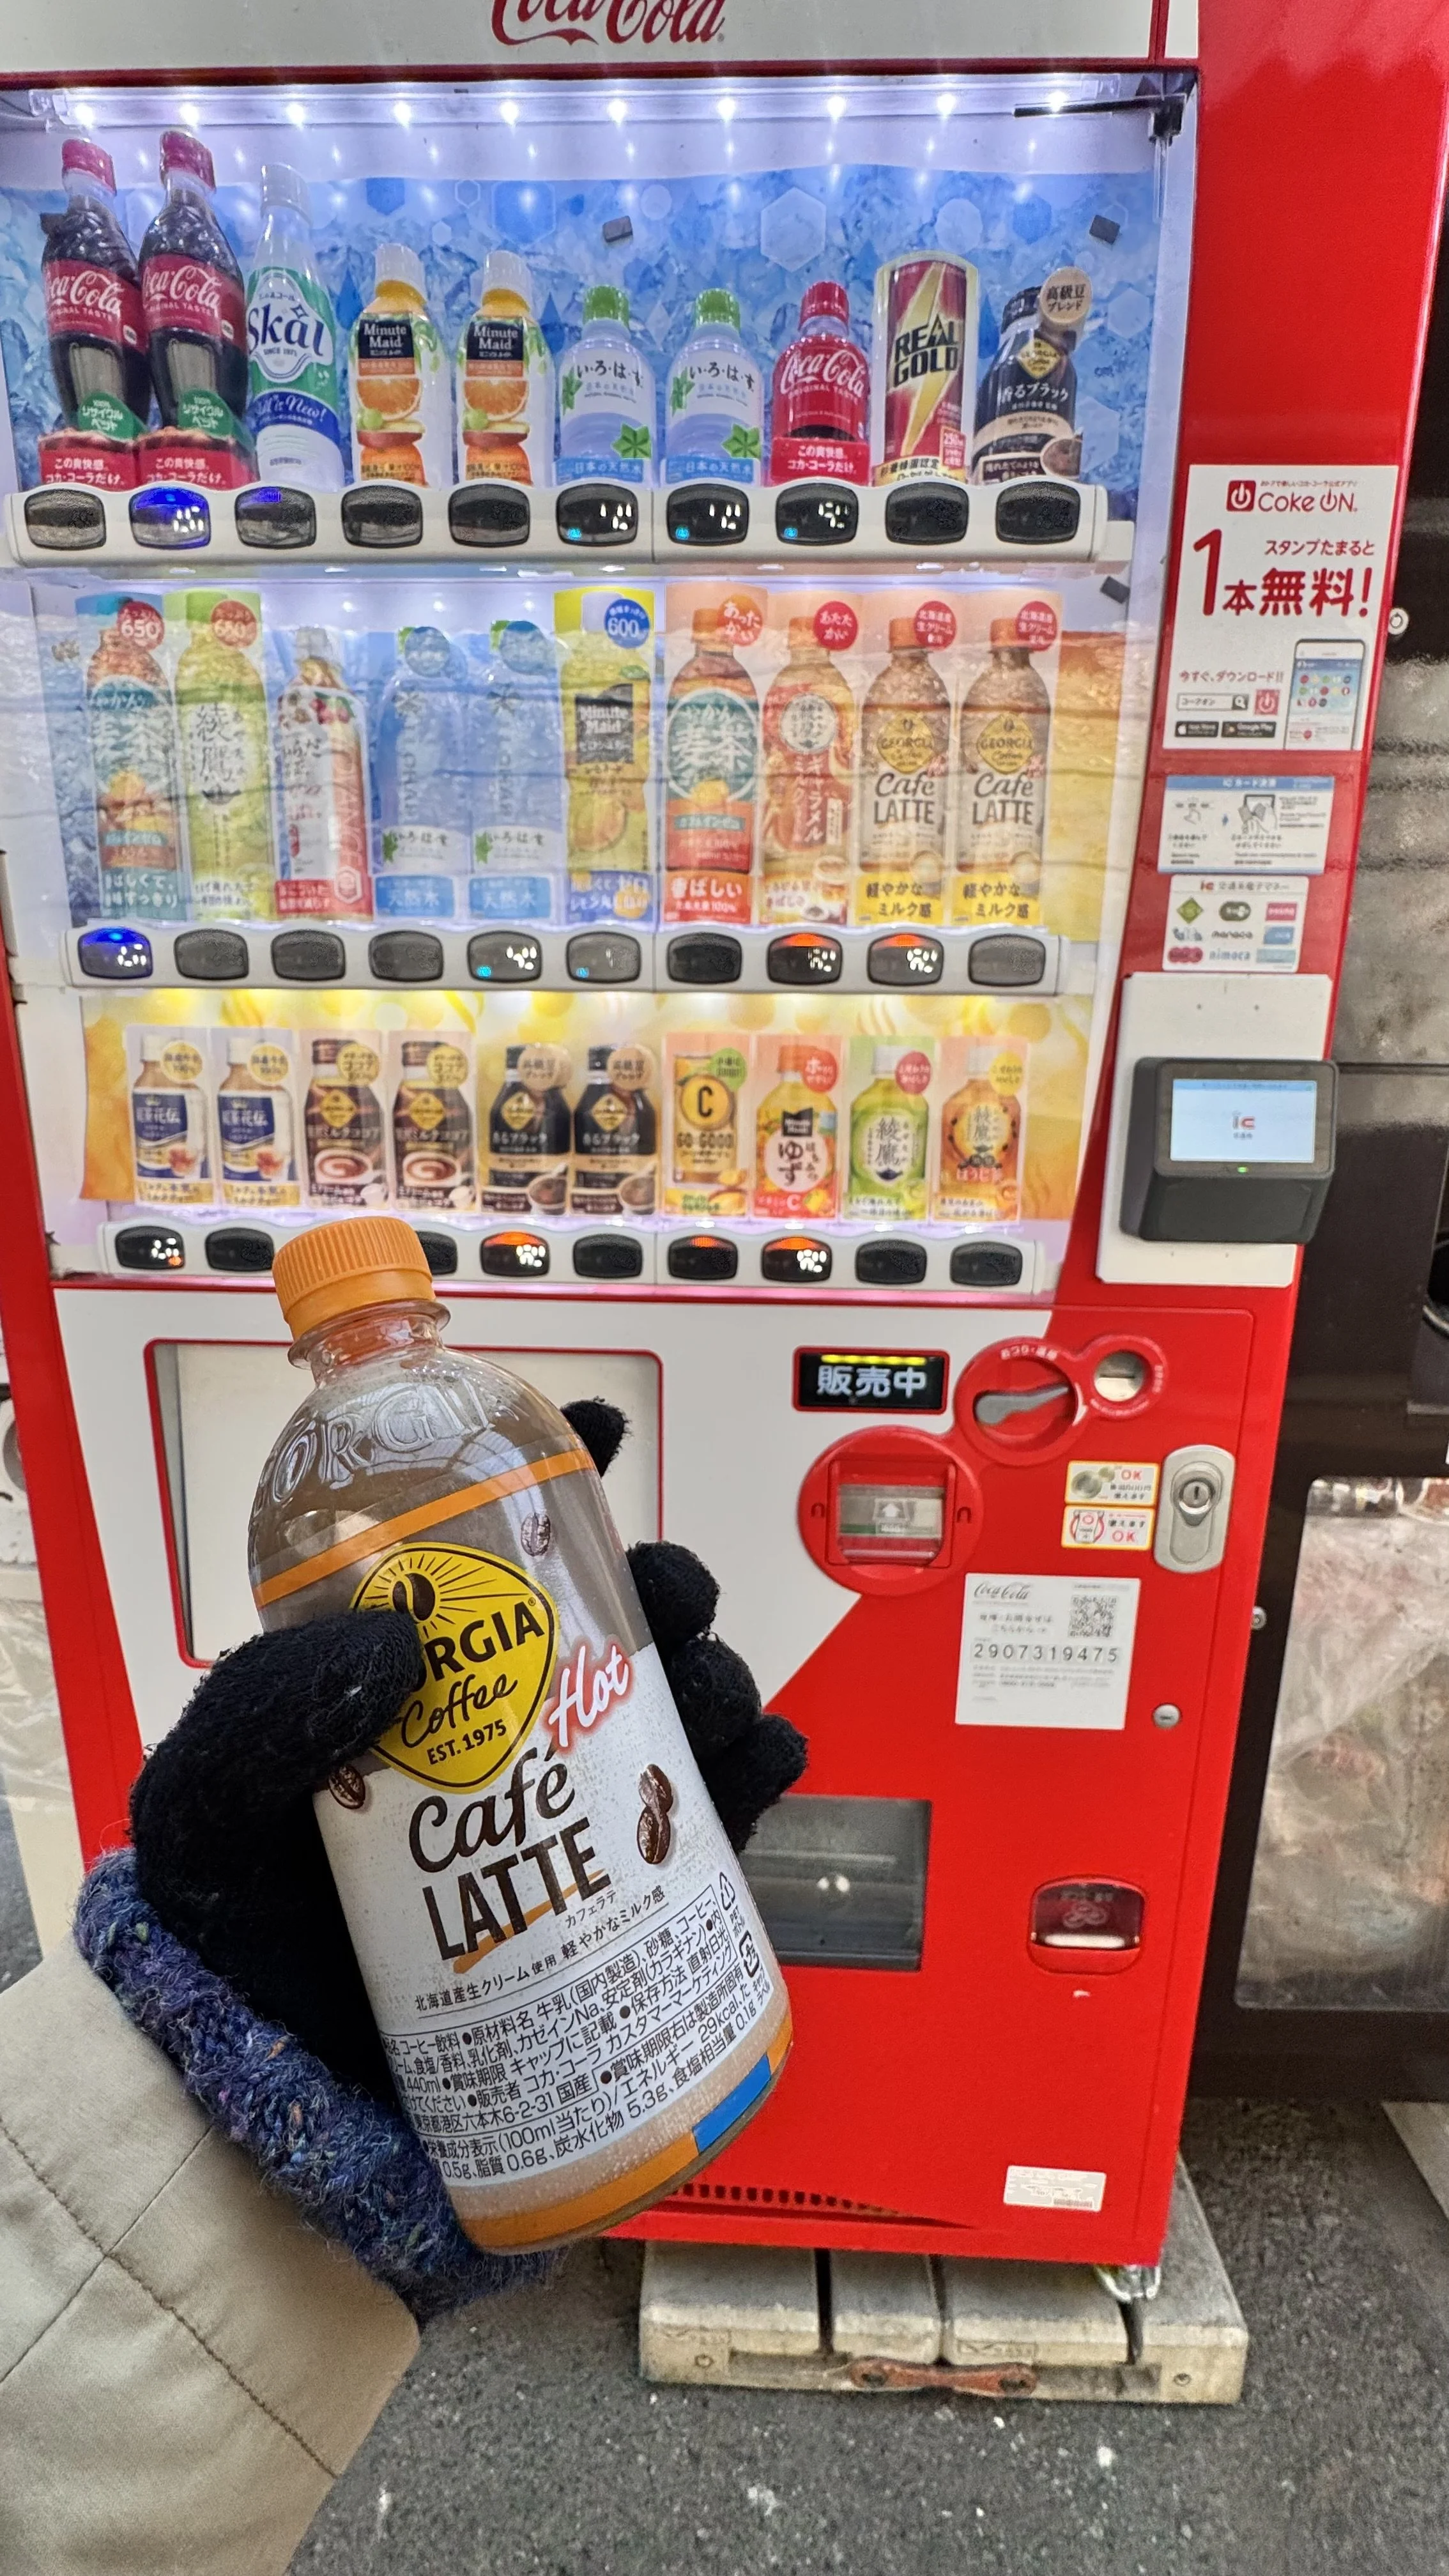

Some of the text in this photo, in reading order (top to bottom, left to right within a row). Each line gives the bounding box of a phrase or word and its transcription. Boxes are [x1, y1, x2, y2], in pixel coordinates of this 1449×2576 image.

[491, 0, 725, 45] CocaCola
[1046, 283, 1087, 300] 高級豆
[1048, 300, 1083, 312] ブレンド
[364, 323, 407, 336] Minute
[473, 325, 519, 339] Minute
[894, 313, 958, 361] REAL
[369, 336, 402, 349] Maid
[479, 337, 512, 351] Maid
[893, 346, 959, 388] GOLD
[788, 384, 831, 400] ORIGINAL
[81, 406, 123, 420] リサイクル
[182, 403, 224, 418] リサイクル
[797, 445, 848, 459] この爽快感。
[54, 457, 109, 471] この爽快感。
[155, 457, 210, 470] この爽快感。
[787, 460, 857, 474] コカ・コーラだけ。
[1257, 491, 1315, 512] Coke
[1264, 539, 1375, 556] スタンプたまると
[1193, 528, 1373, 617] 1本無料!
[723, 601, 762, 627] あった
[819, 609, 853, 627] あたた
[120, 619, 160, 636] 650
[824, 626, 849, 640] かい
[916, 622, 953, 634] 生クリーム
[585, 719, 623, 735] Maid
[673, 726, 751, 769] 麦茶
[978, 737, 1033, 750] GEORGIA
[806, 756, 825, 842] キャラメル
[873, 799, 935, 825] LATTE
[972, 799, 1034, 825] LATTE
[670, 878, 743, 898] 香ばしい
[866, 881, 923, 900] 軽やかな
[963, 881, 1021, 900] 軽やかな
[878, 901, 932, 919] ミルク感
[976, 901, 1029, 919] ミルク感
[1211, 930, 1254, 940] manaca
[1209, 948, 1251, 962] nimoca
[696, 1085, 714, 1118] C
[777, 1140, 804, 1186] ゆず
[816, 1365, 928, 1398] 販売中
[1121, 1469, 1142, 1480] OK
[1112, 1529, 1135, 1542] OK
[418, 1600, 544, 1687] RGIA
[974, 1643, 1119, 1662] 2907319475
[548, 1644, 629, 1748] Hot
[401, 1673, 519, 1749] Coffee
[426, 1717, 507, 1766] EST. 1975
[408, 1736, 576, 1873] Café
[422, 1816, 611, 1961] LATTE
[565, 1889, 617, 1929] カフェラテ
[729, 1904, 740, 1924] PET
[560, 1885, 666, 1960] 軽やかなミルク感
[510, 2012, 617, 2076] キャップに記載
[686, 1925, 728, 1975] 直射日光
[523, 2044, 602, 2094] コカ・コーラ
[606, 1940, 733, 2055] カスタマーマーケティング
[735, 2000, 757, 2030] 0.1g
[399, 2031, 461, 2055] コーヒー飲料
[556, 2072, 593, 2105] 国産
